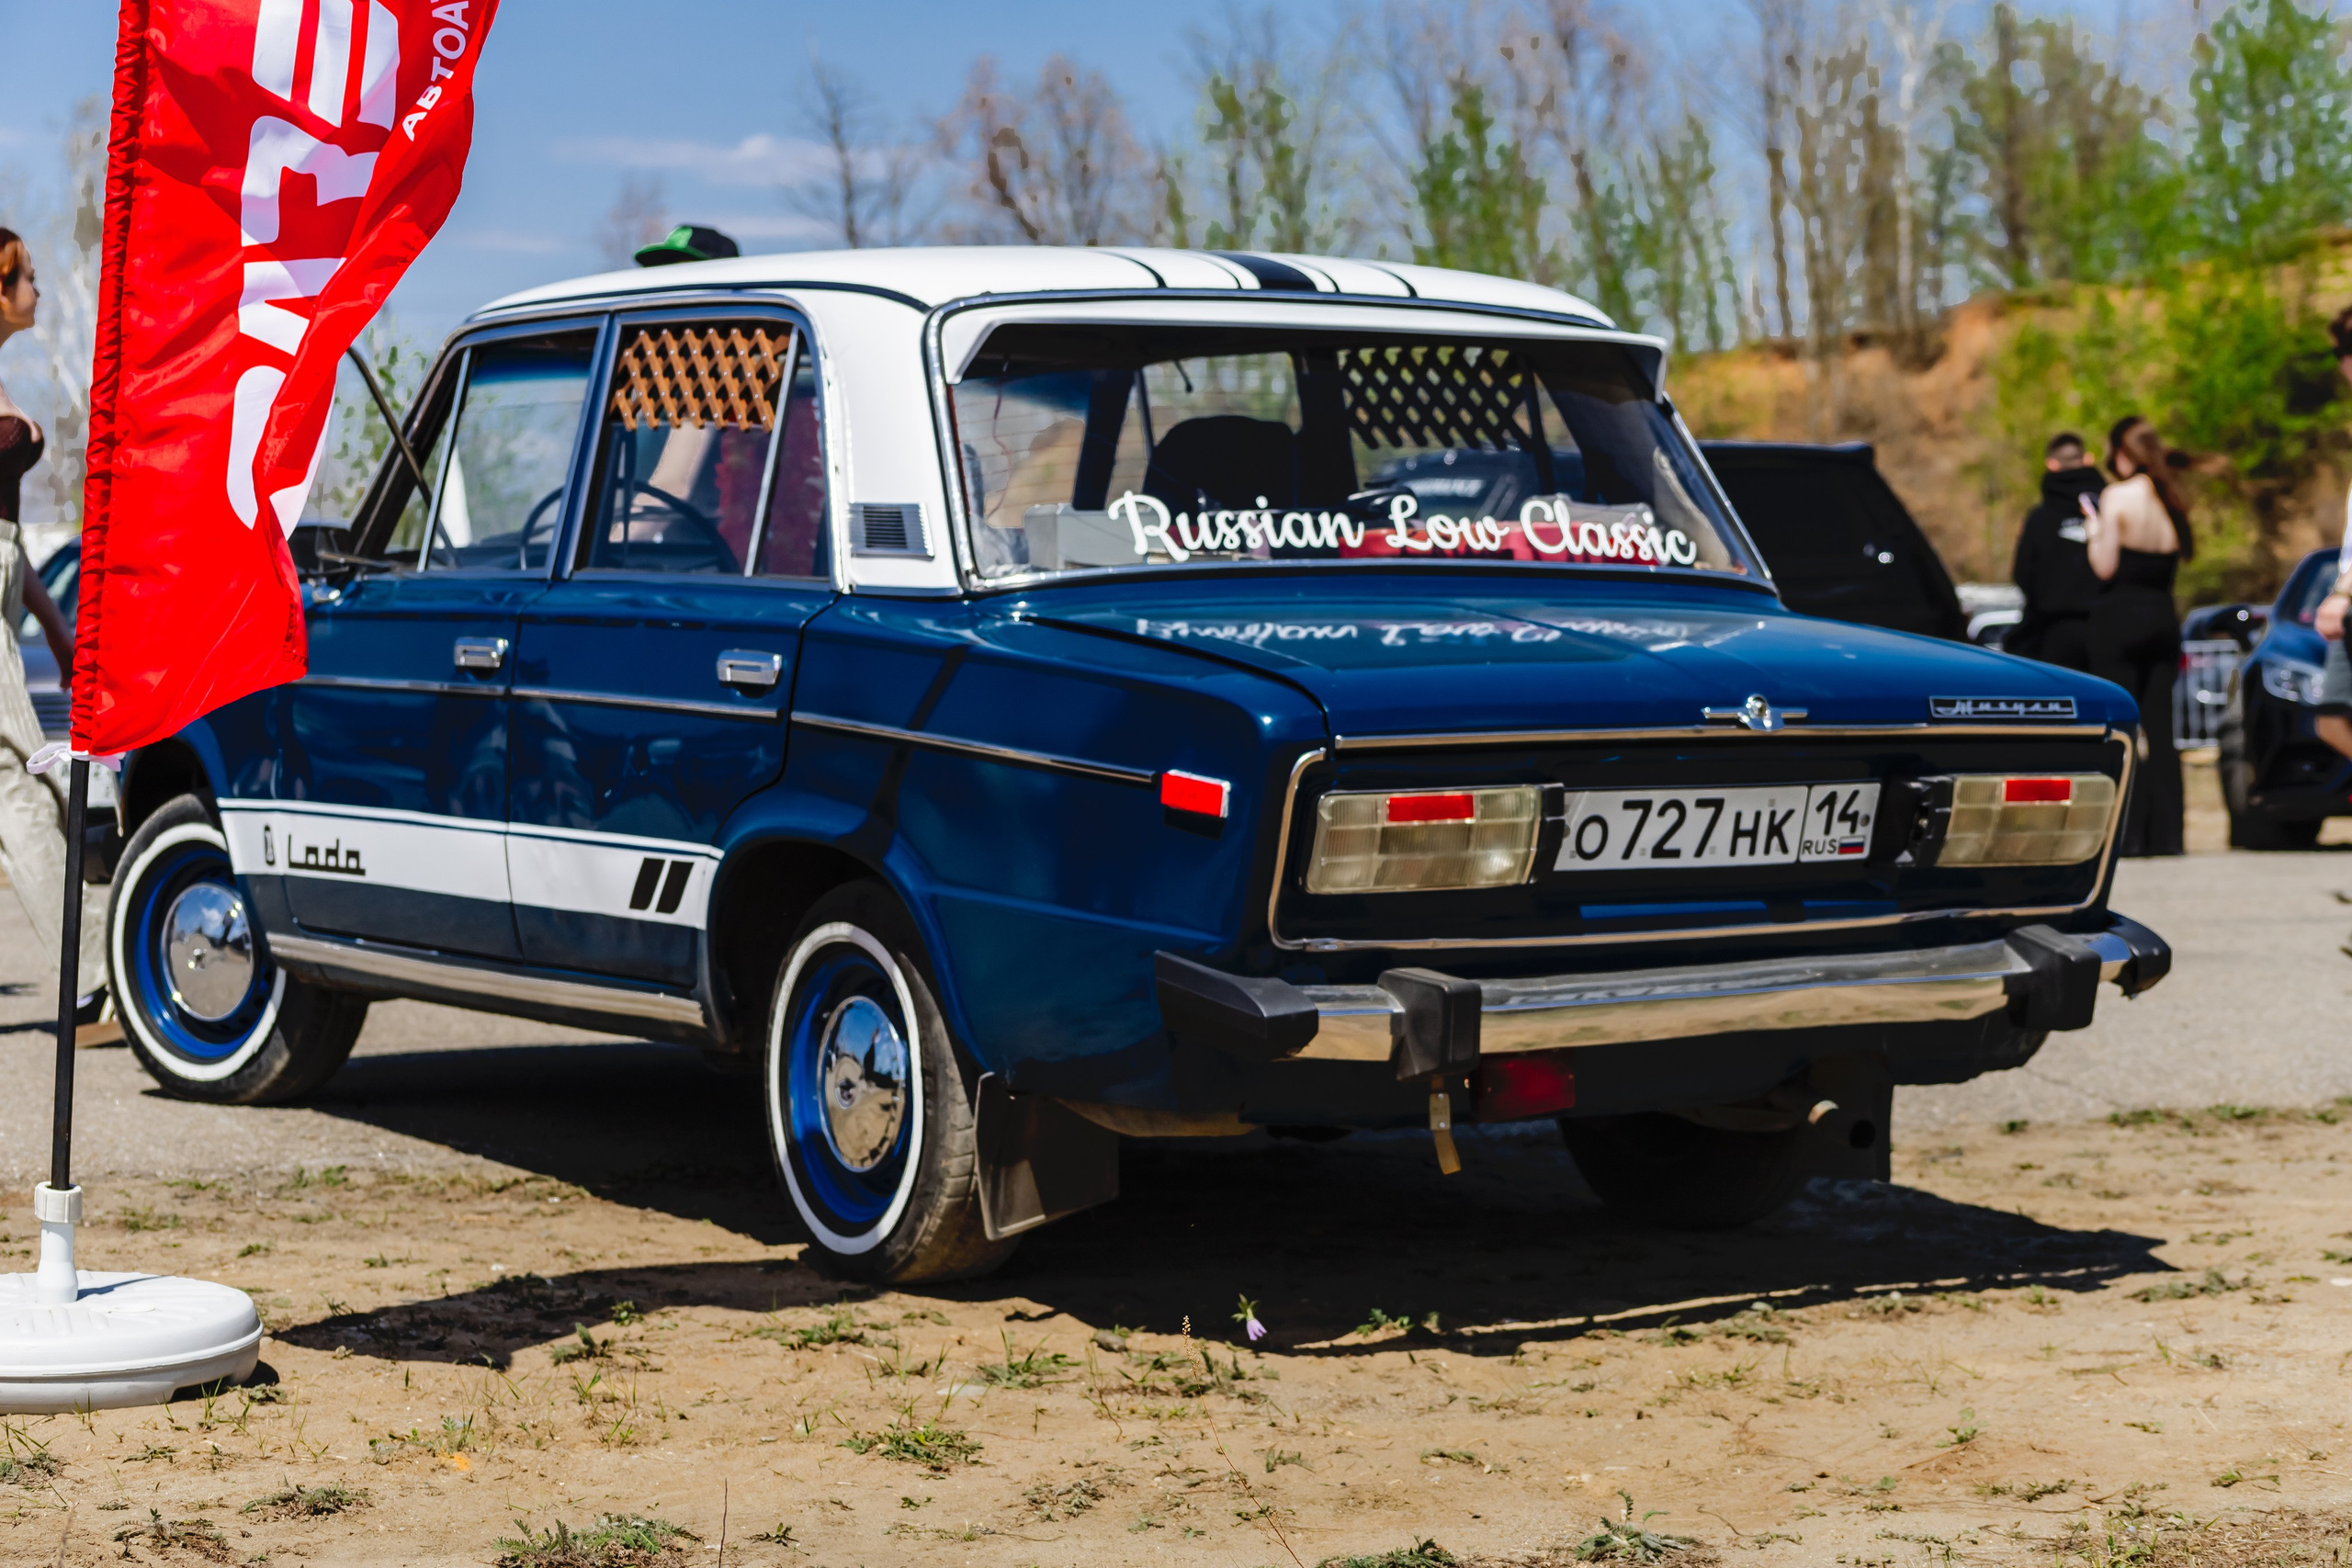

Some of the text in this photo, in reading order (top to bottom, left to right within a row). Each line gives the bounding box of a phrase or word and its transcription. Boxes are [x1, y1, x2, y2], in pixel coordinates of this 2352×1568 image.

[402, 0, 469, 142] АВТОА
[1108, 491, 1697, 566] Russian Low Classic
[1815, 789, 1860, 837] 14
[288, 833, 367, 876] Lada
[1802, 838, 1838, 855] RUS
